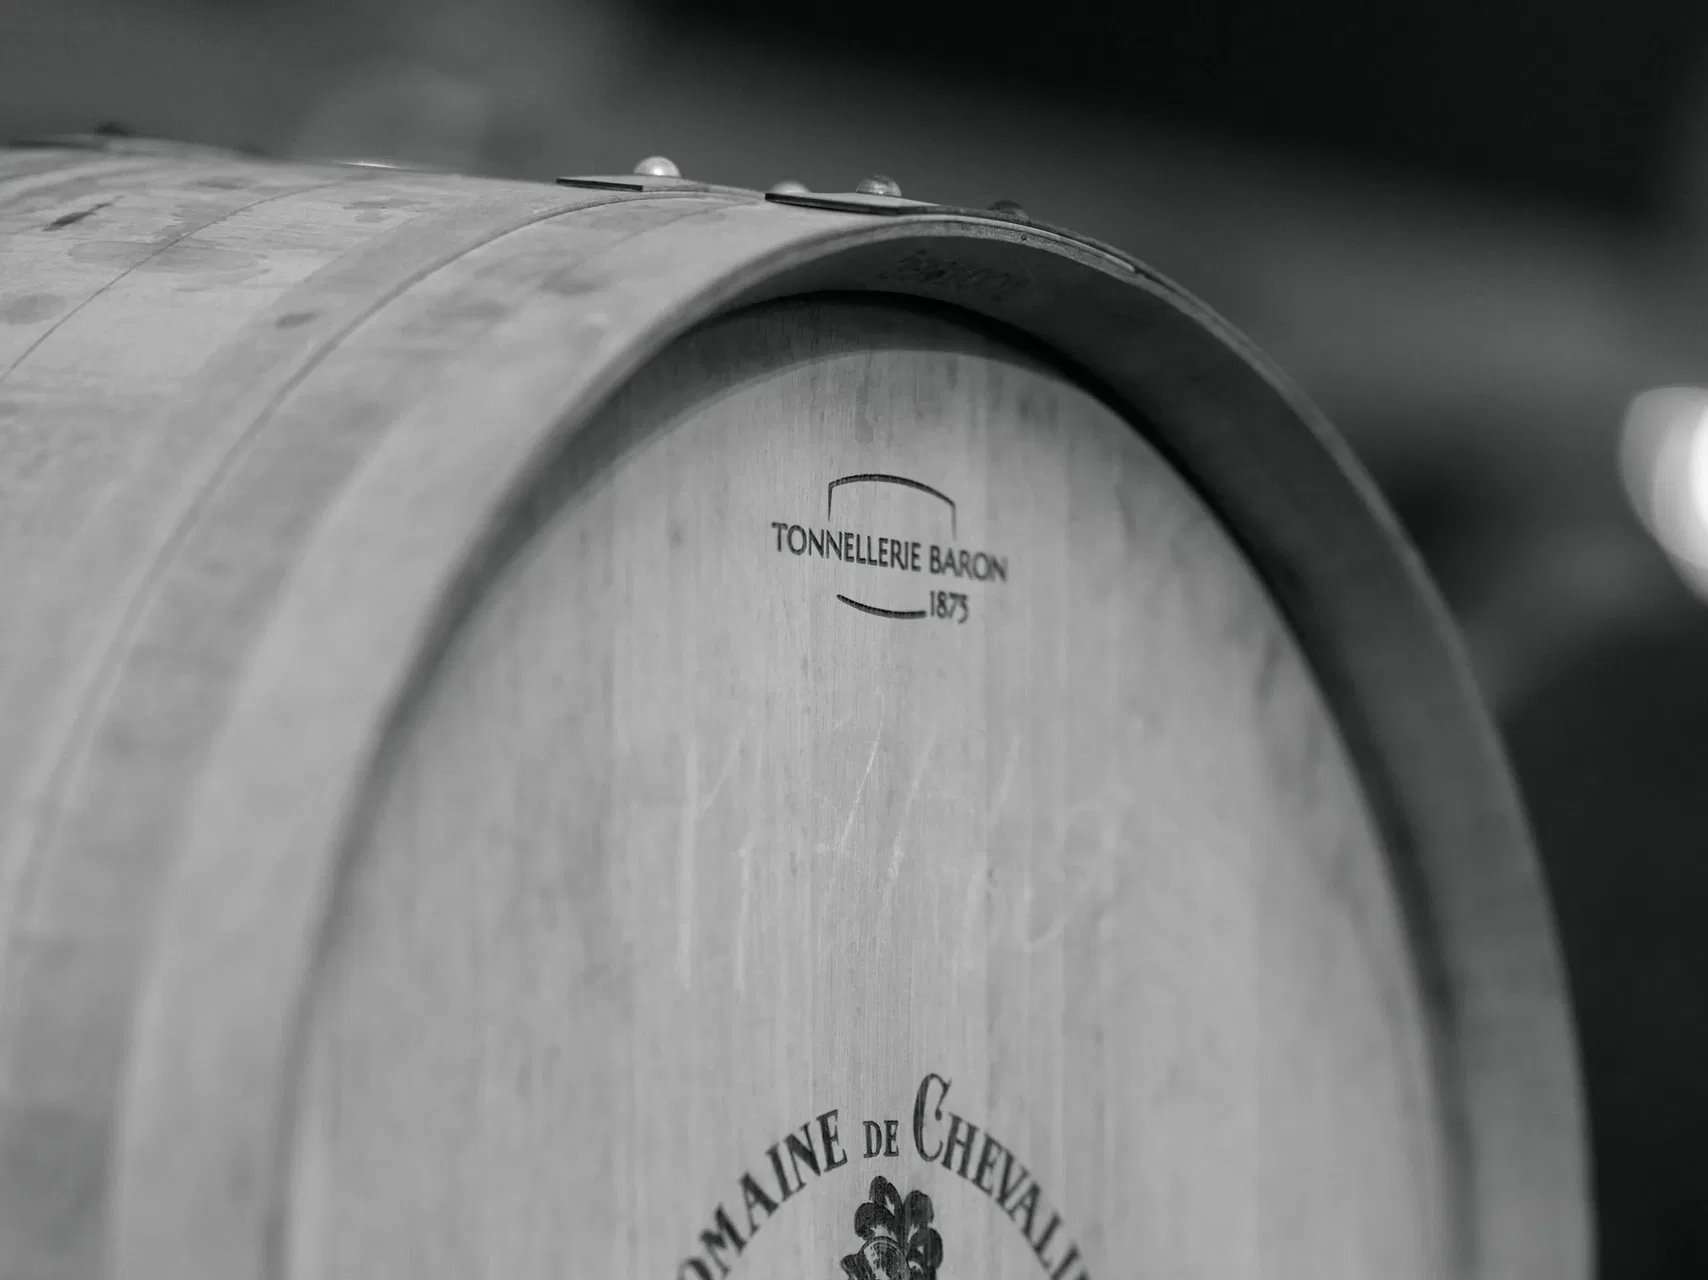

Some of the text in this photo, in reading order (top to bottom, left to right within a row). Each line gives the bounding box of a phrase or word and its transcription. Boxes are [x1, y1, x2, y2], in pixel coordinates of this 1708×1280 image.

[771, 521, 1008, 582] TONNELLERIE BARON
[863, 1120, 900, 1158] DE
